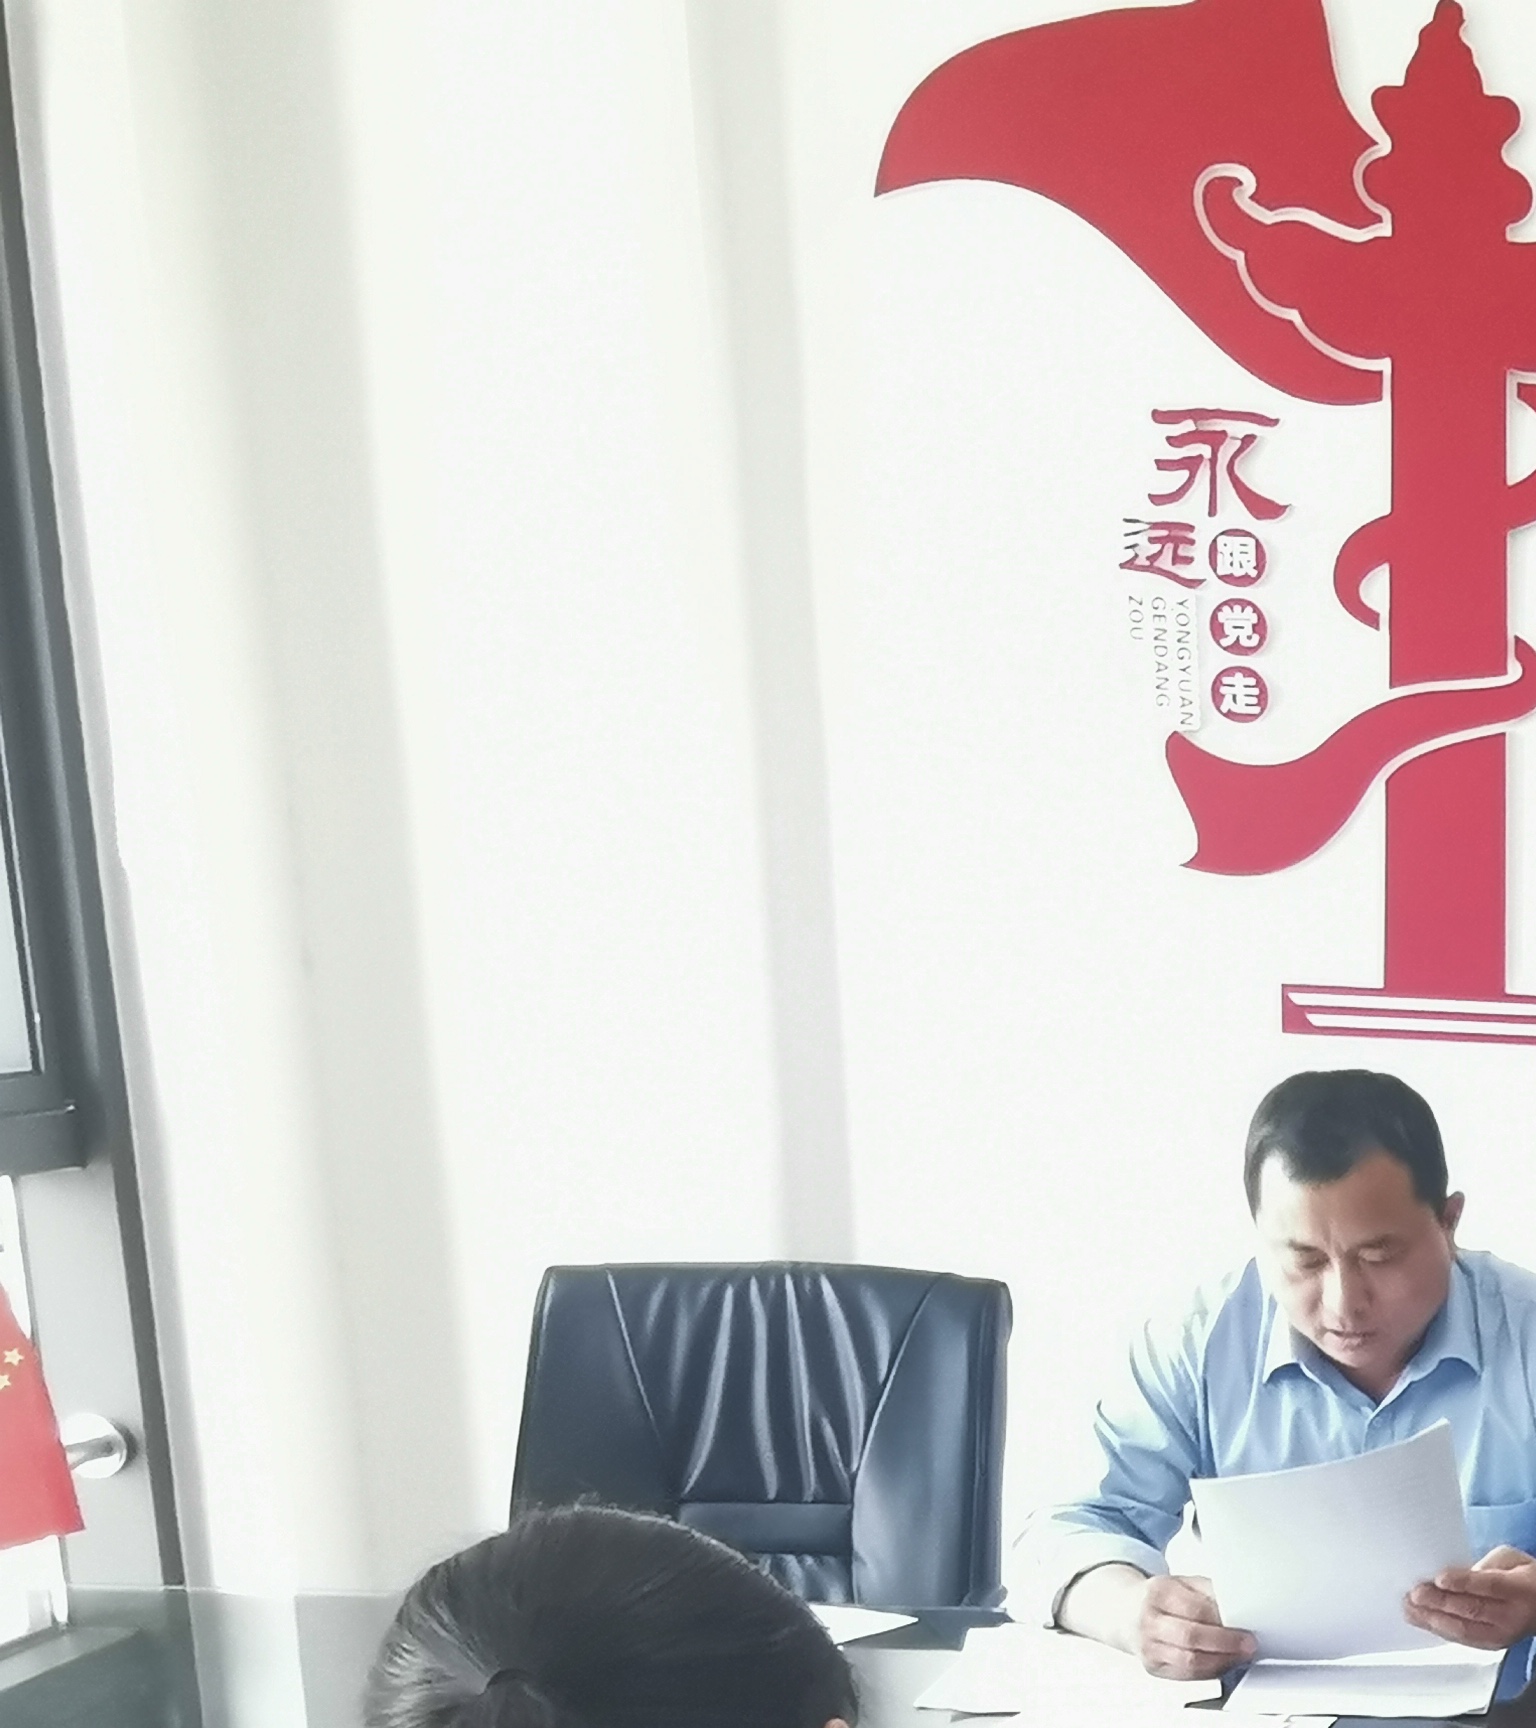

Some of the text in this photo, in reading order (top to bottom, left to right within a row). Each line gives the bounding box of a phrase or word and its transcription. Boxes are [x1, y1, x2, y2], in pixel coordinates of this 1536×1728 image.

[1119, 408, 1292, 717] 永远 跟党走
[1127, 595, 1144, 642] ZOU
[1151, 596, 1171, 708] GENDANG
[1174, 598, 1195, 727] YONGYUAN
